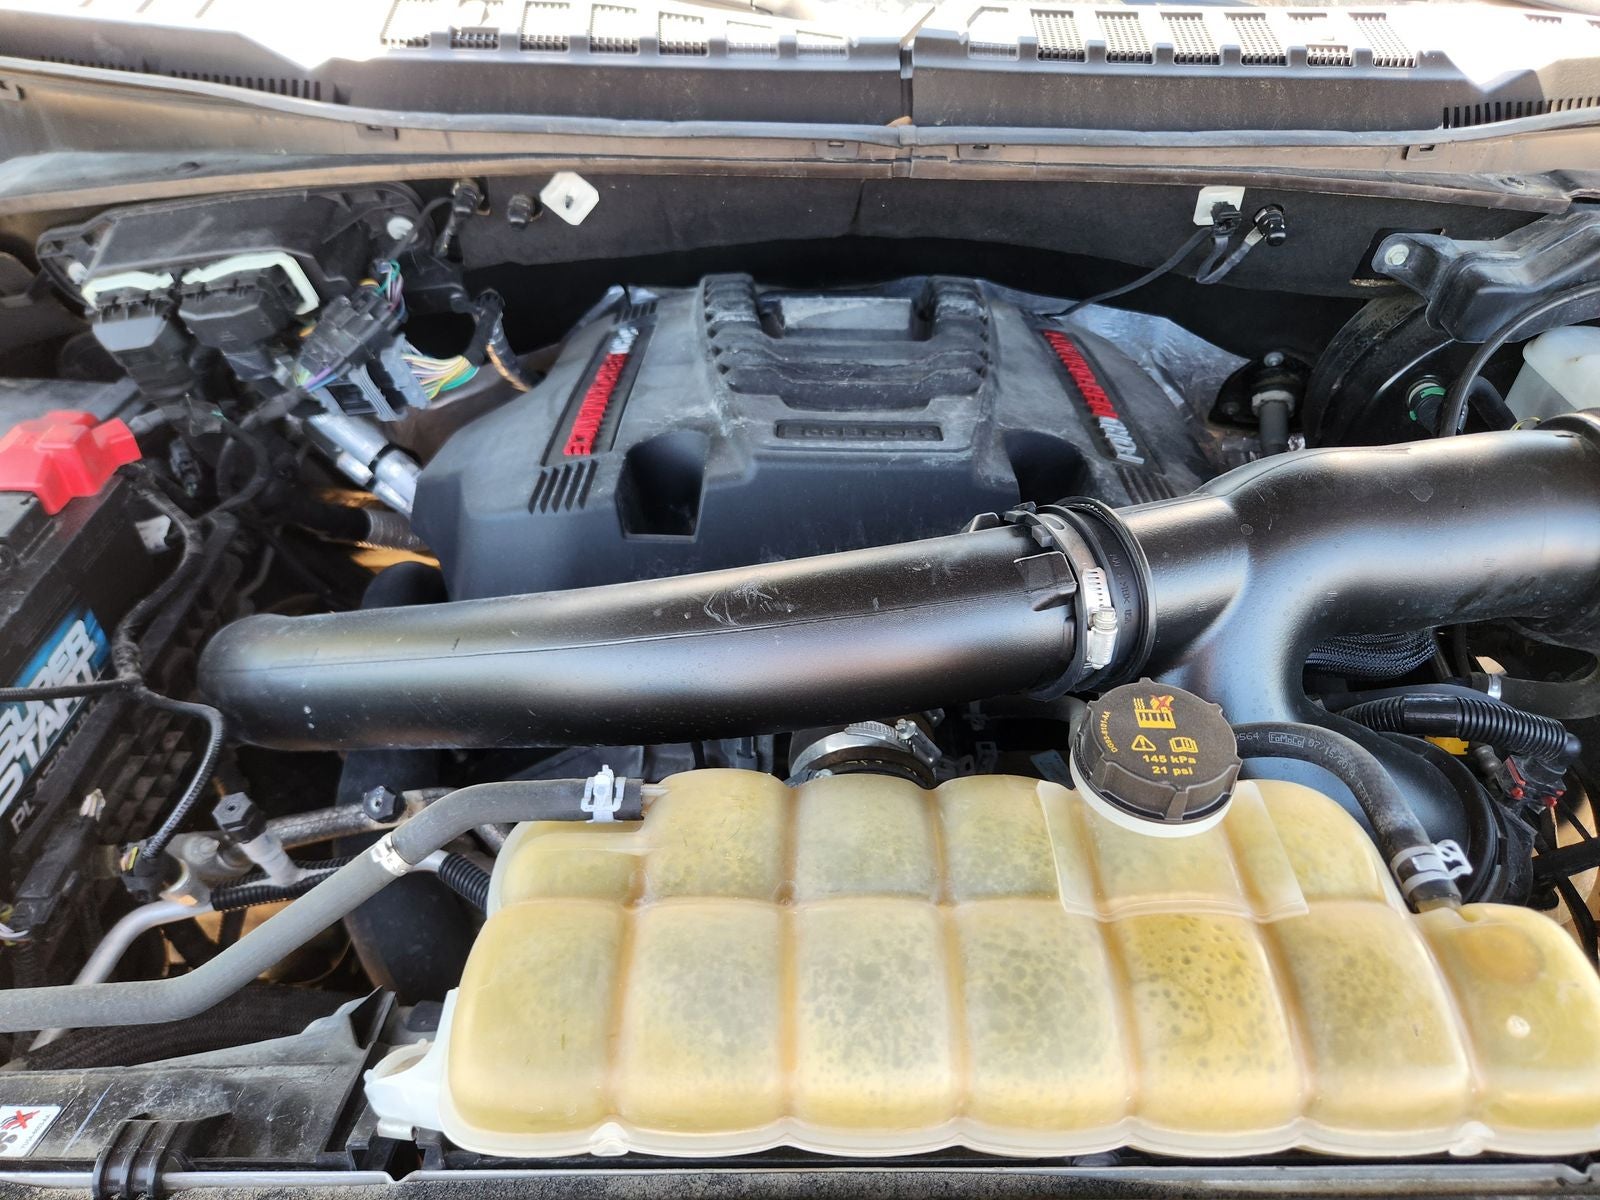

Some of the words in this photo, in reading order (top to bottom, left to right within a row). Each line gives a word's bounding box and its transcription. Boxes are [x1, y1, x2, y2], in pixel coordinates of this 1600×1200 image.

[1142, 755, 1167, 763] 145
[1170, 756, 1196, 764] kPa
[1152, 765, 1168, 774] 21
[1172, 766, 1193, 776] psi
